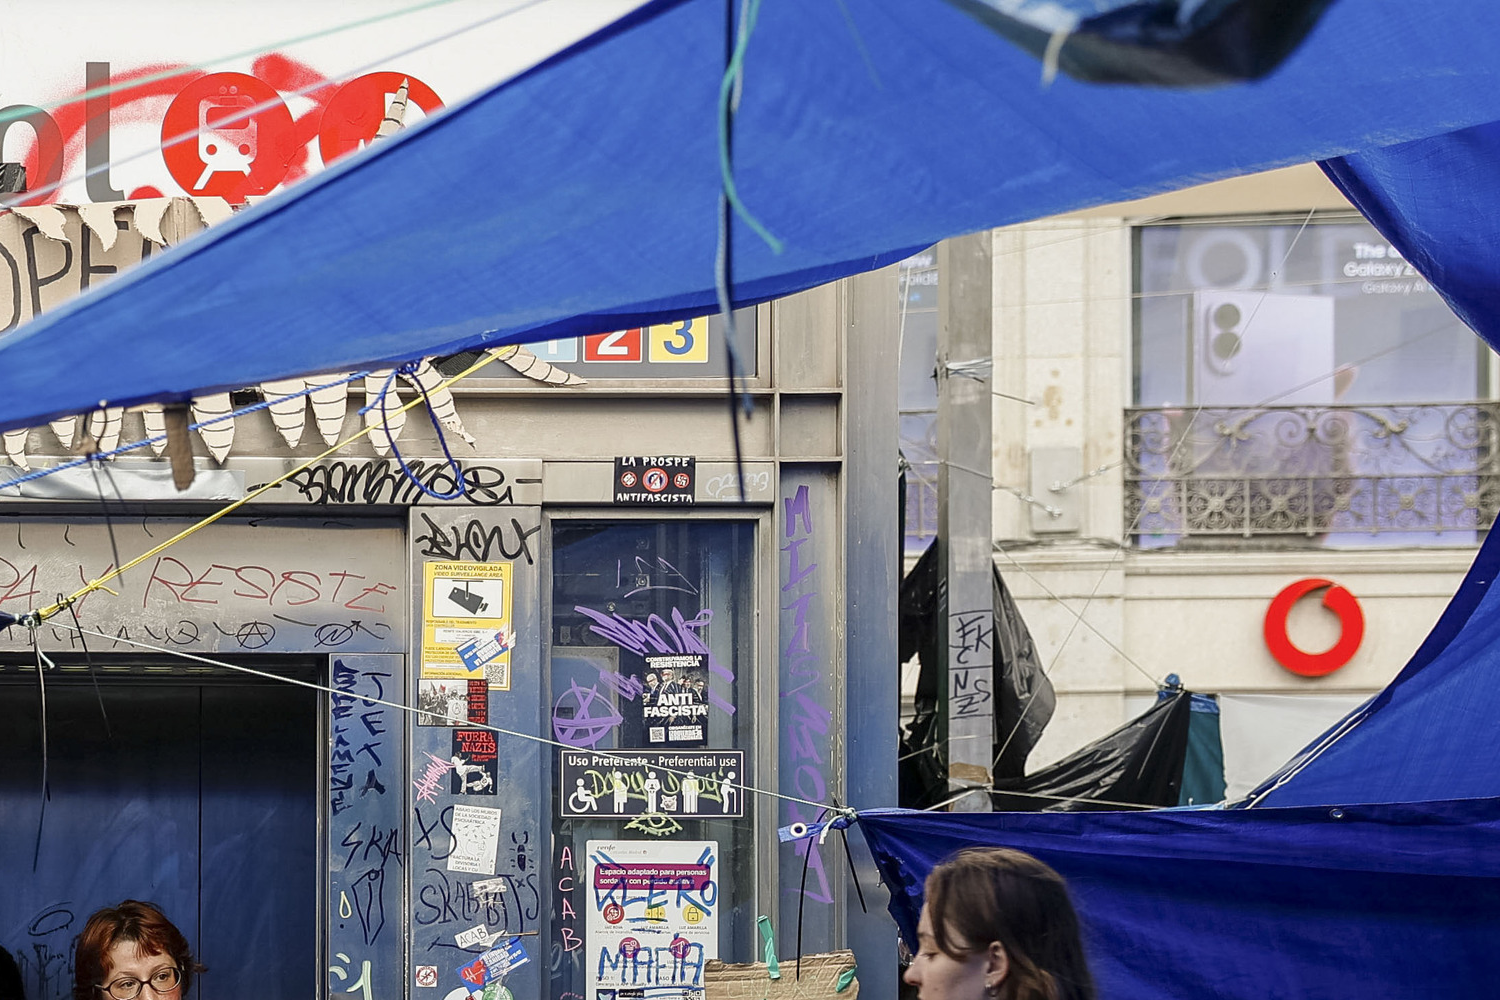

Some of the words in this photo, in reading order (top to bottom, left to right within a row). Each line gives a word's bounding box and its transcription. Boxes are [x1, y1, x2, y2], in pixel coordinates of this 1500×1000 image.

[663, 318, 694, 355] 3
[622, 456, 636, 467] LA
[643, 456, 690, 467] PROSPE
[616, 492, 693, 503] ANTIFASCISTA
[650, 660, 700, 668] RESISTENCIA
[657, 693, 693, 706] ANTI
[643, 705, 707, 718] FASCISTA
[456, 731, 494, 743] FUERA
[461, 742, 496, 754] NAZIS
[568, 755, 589, 767] Uso
[658, 755, 717, 767] Preferential
[719, 758, 737, 767] use
[627, 868, 658, 876] adaptado
[659, 869, 675, 877] para
[676, 869, 707, 877] personas
[558, 846, 582, 952] ACAB
[459, 927, 488, 946] ACAB
